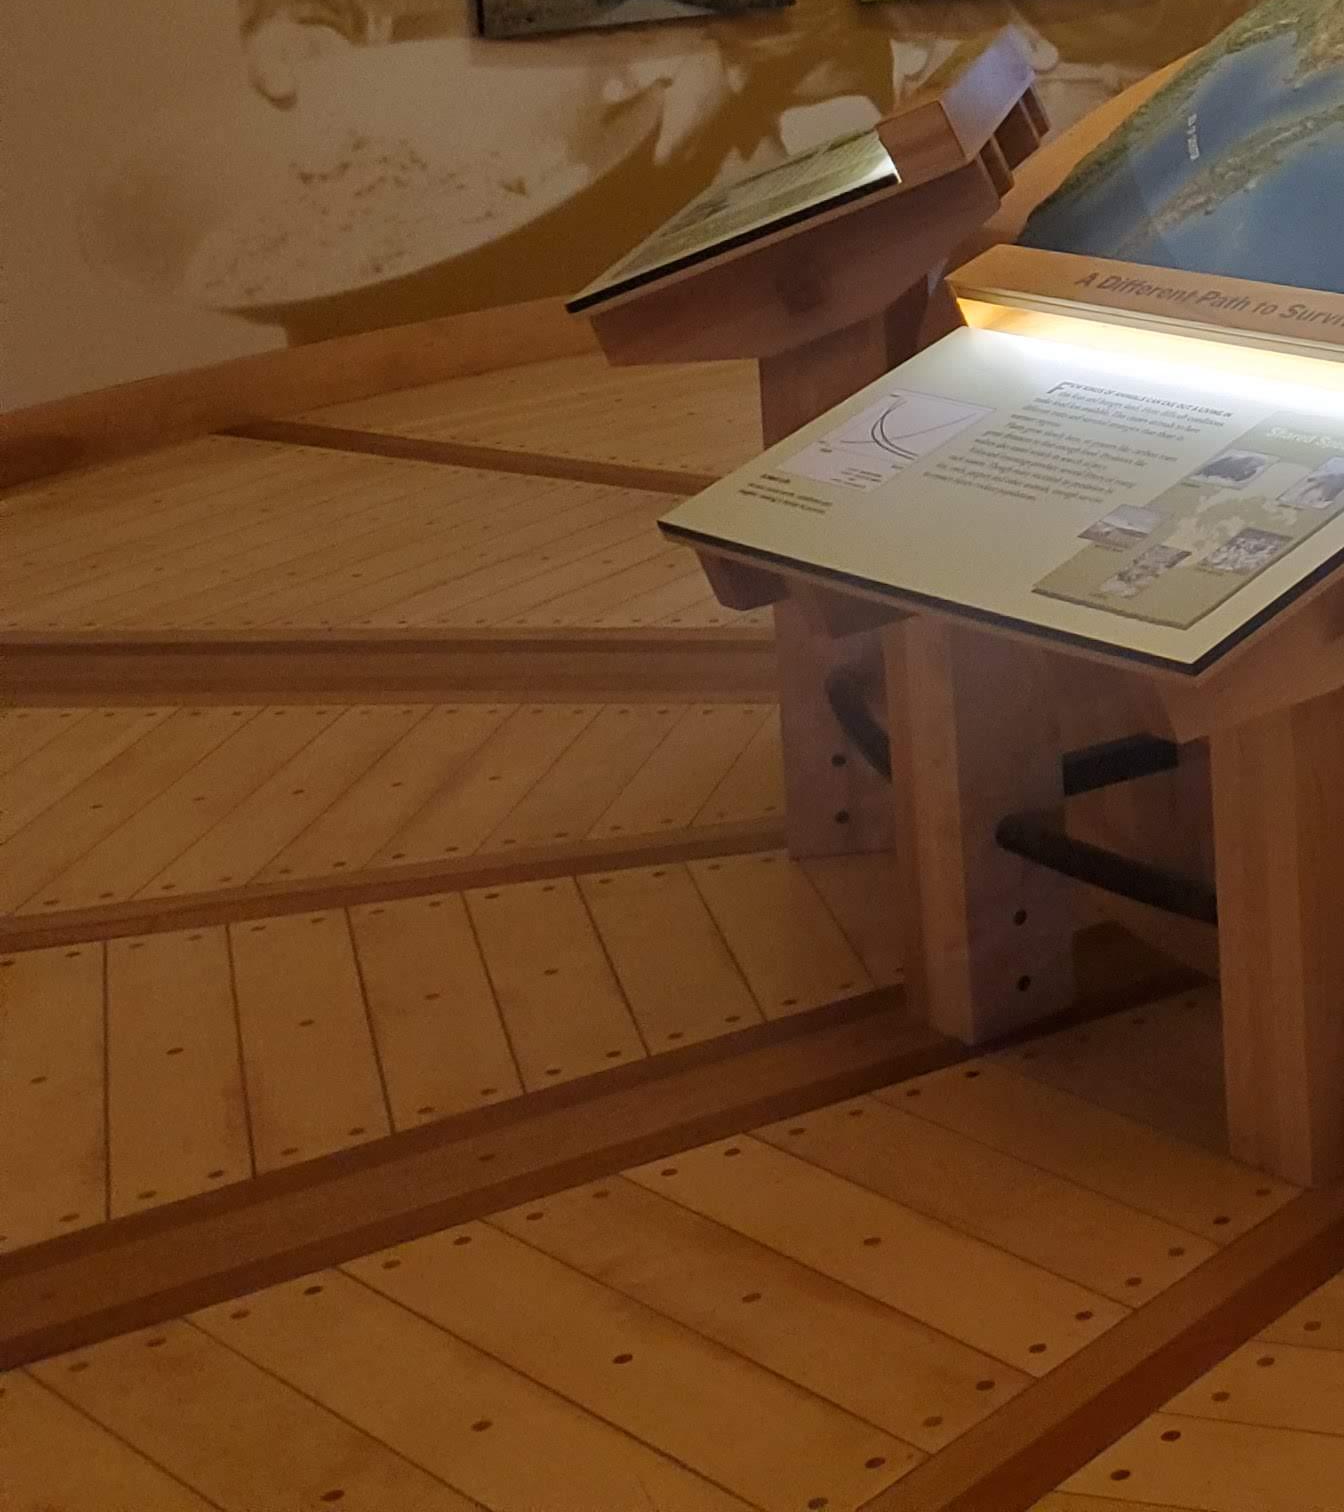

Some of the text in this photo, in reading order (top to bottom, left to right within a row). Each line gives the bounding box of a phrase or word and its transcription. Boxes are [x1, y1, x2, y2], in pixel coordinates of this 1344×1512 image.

[1075, 272, 1099, 287] A
[1096, 275, 1197, 304] Different
[1197, 291, 1250, 311] Path
[1251, 301, 1277, 315] to
